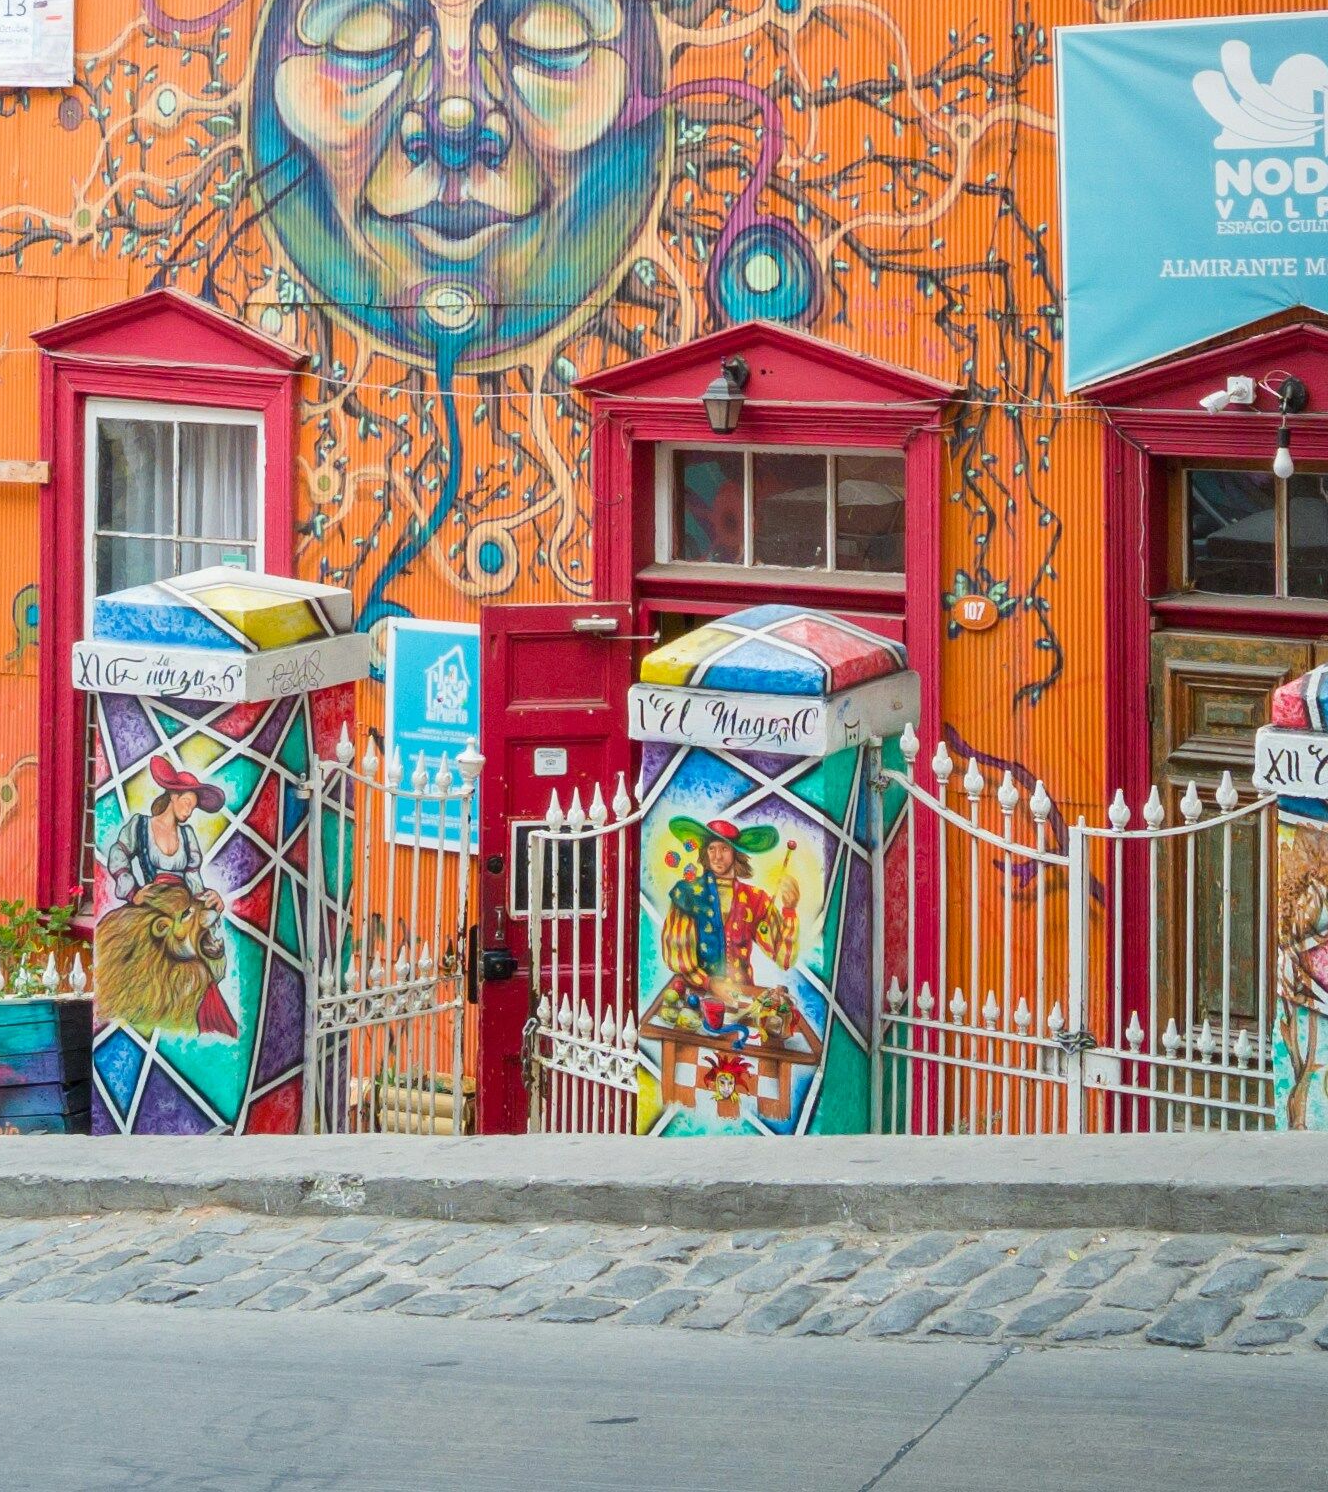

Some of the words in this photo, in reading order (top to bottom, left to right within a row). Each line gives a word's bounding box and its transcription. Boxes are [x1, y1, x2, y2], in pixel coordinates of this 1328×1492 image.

[1216, 219, 1284, 235] ESPACIO
[1160, 258, 1298, 278] ALMIRANTE
[964, 601, 986, 621] 107
[705, 698, 784, 748] Mago
[1264, 747, 1302, 786] XII
